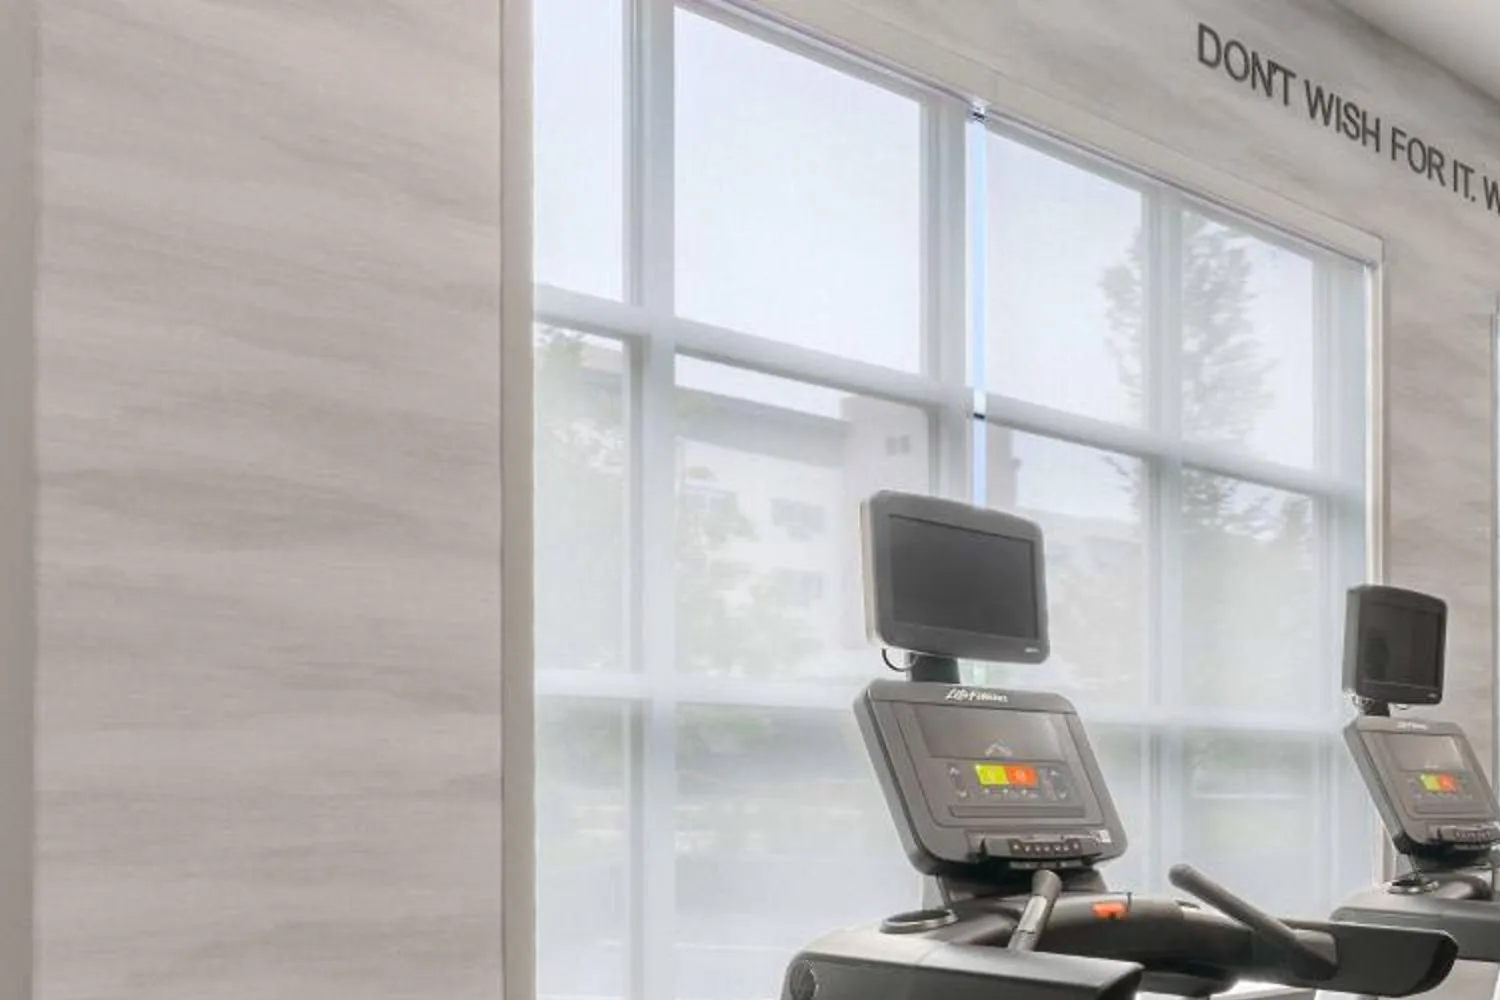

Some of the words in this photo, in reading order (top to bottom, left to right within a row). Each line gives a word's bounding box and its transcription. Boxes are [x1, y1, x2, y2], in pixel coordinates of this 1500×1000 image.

[1197, 22, 1296, 106] DON'T
[1304, 79, 1381, 153] WISH
[1390, 126, 1446, 187] FOR
[1452, 159, 1477, 203] IT.
